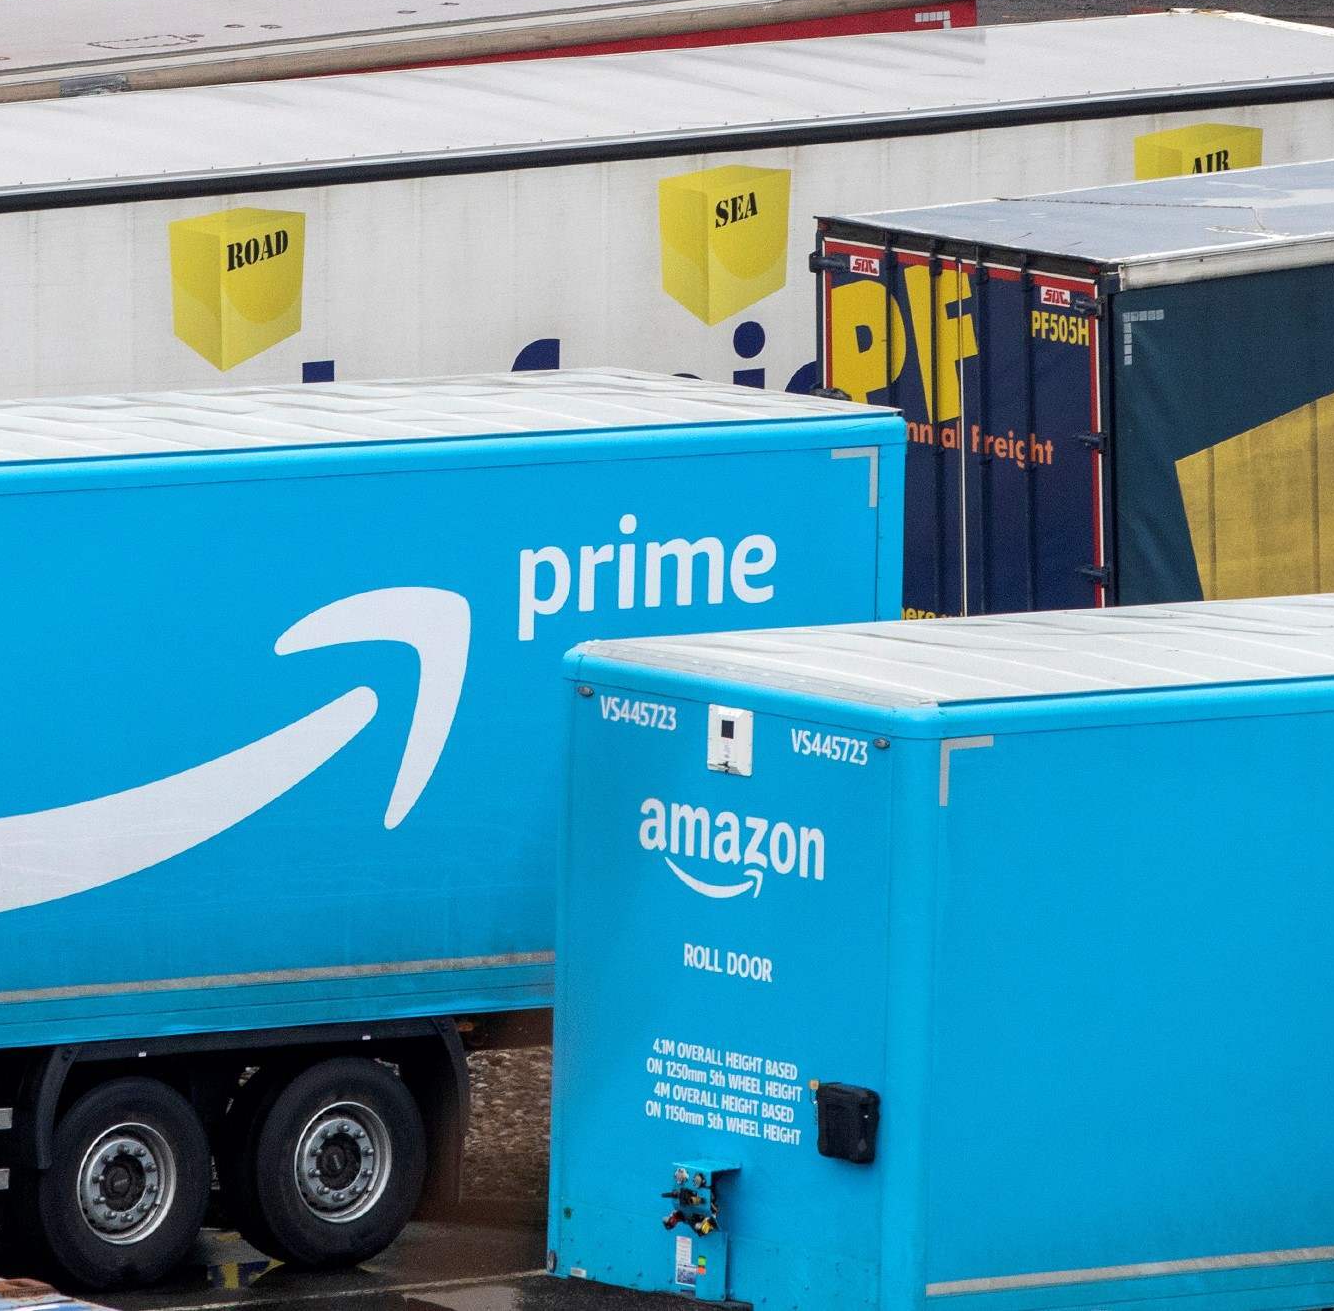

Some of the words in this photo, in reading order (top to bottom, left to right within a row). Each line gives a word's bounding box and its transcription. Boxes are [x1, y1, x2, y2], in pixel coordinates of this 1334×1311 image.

[714, 191, 759, 230] SEA
[226, 228, 289, 273] ROAD
[831, 264, 980, 424] PF
[1031, 310, 1090, 347] PF505H
[519, 513, 778, 642] prime
[599, 695, 677, 731] VS445723
[791, 728, 869, 766] VS445723
[639, 797, 826, 882] amazon
[684, 942, 723, 974] ROLL
[727, 951, 773, 983] DOOR
[646, 1057, 663, 1075] ON
[665, 1060, 707, 1084] 1250mm
[709, 1069, 726, 1088] 5th
[728, 1073, 763, 1096] WHEEL
[765, 1080, 803, 1103] HEIGHT
[652, 1038, 675, 1057] 4.1M
[677, 1041, 723, 1067] OVERALL
[725, 1051, 763, 1074] HEIGHT
[765, 1059, 798, 1081] BASED
[645, 1100, 661, 1119] ON
[665, 1104, 704, 1127] 1150mm
[707, 1112, 723, 1130] 5th
[726, 1116, 762, 1138] WHEEL
[763, 1123, 801, 1146] HEIGHT
[654, 1081, 670, 1099] 4M
[673, 1084, 719, 1109] OVERALL
[721, 1093, 759, 1116] HEIGHT
[761, 1102, 794, 1123] BASED
